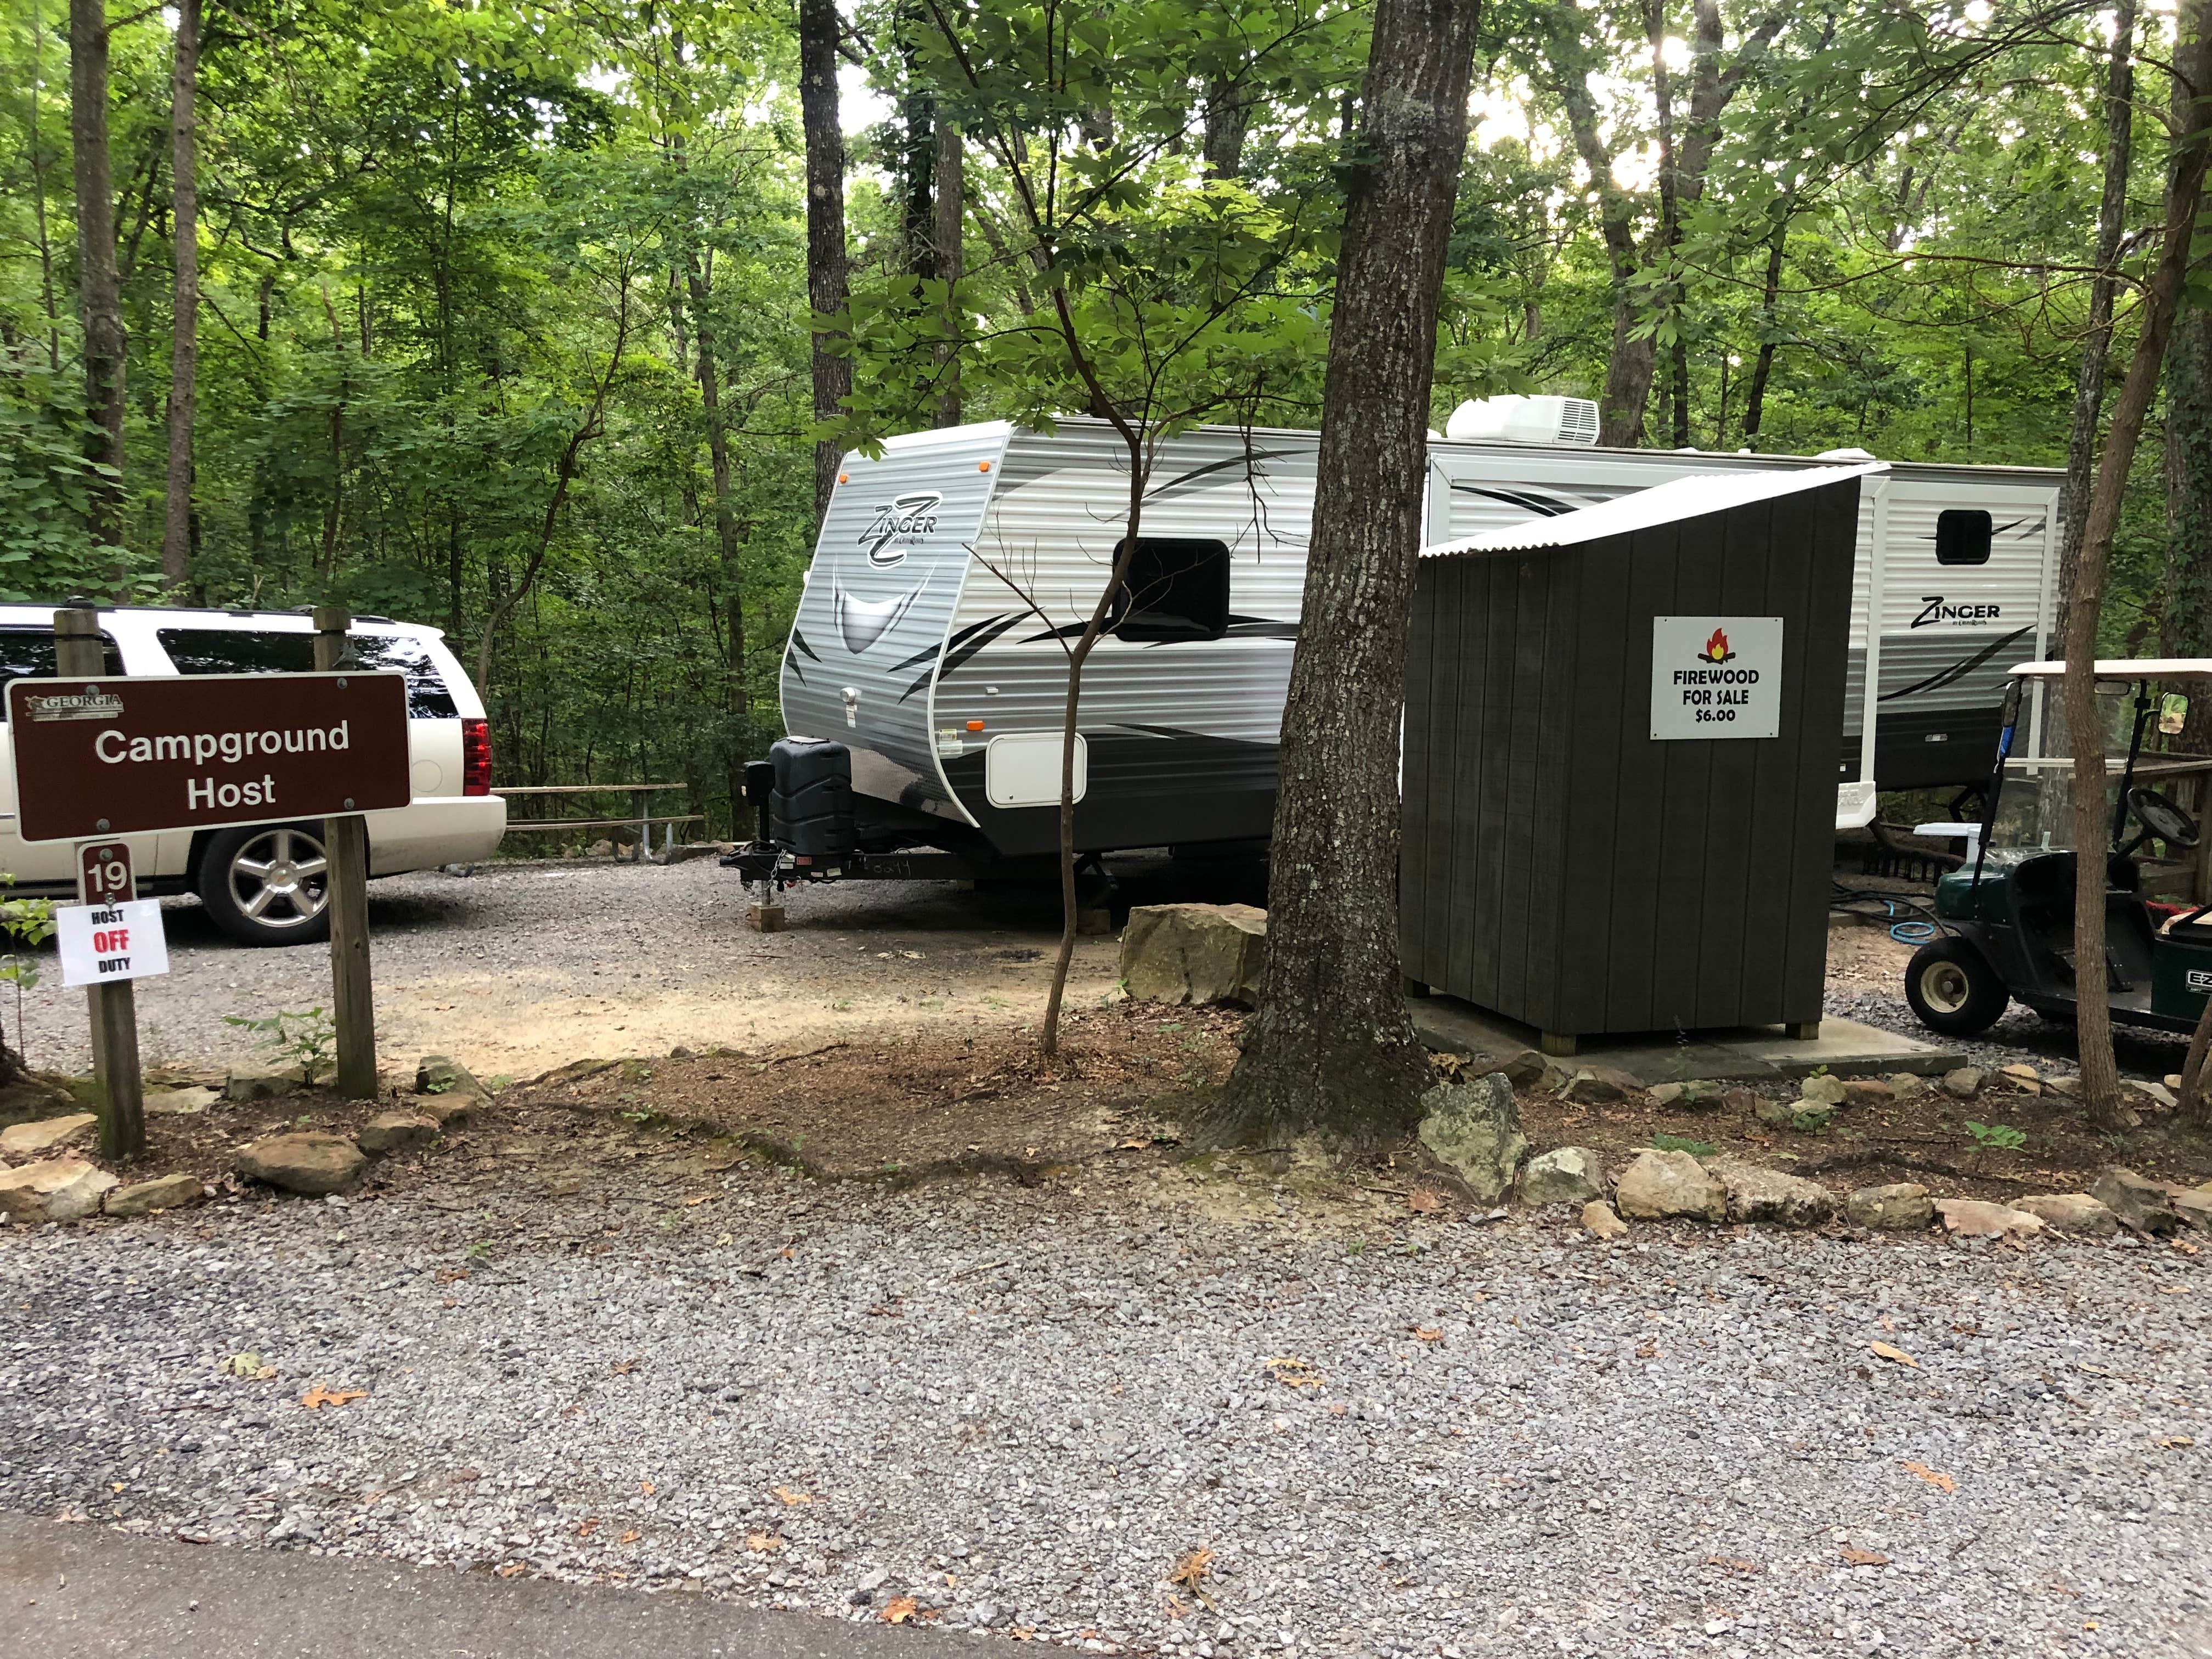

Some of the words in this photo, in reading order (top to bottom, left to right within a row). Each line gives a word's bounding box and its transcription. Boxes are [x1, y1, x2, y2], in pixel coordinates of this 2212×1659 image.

[857, 504, 939, 546] ZINGER
[1910, 596, 2000, 629] ZINGER
[1673, 669, 1759, 685] FIREWOOD
[47, 694, 122, 708] GEORGIA
[1683, 690, 1712, 705] FOR
[1717, 690, 1749, 705] SALE
[1695, 708, 1736, 723] $6.00
[95, 720, 349, 765] Campground
[188, 774, 276, 810] Host
[88, 861, 127, 892] 19
[91, 909, 124, 925] HOST
[93, 929, 129, 953] OFF
[98, 957, 131, 973] DUTY
